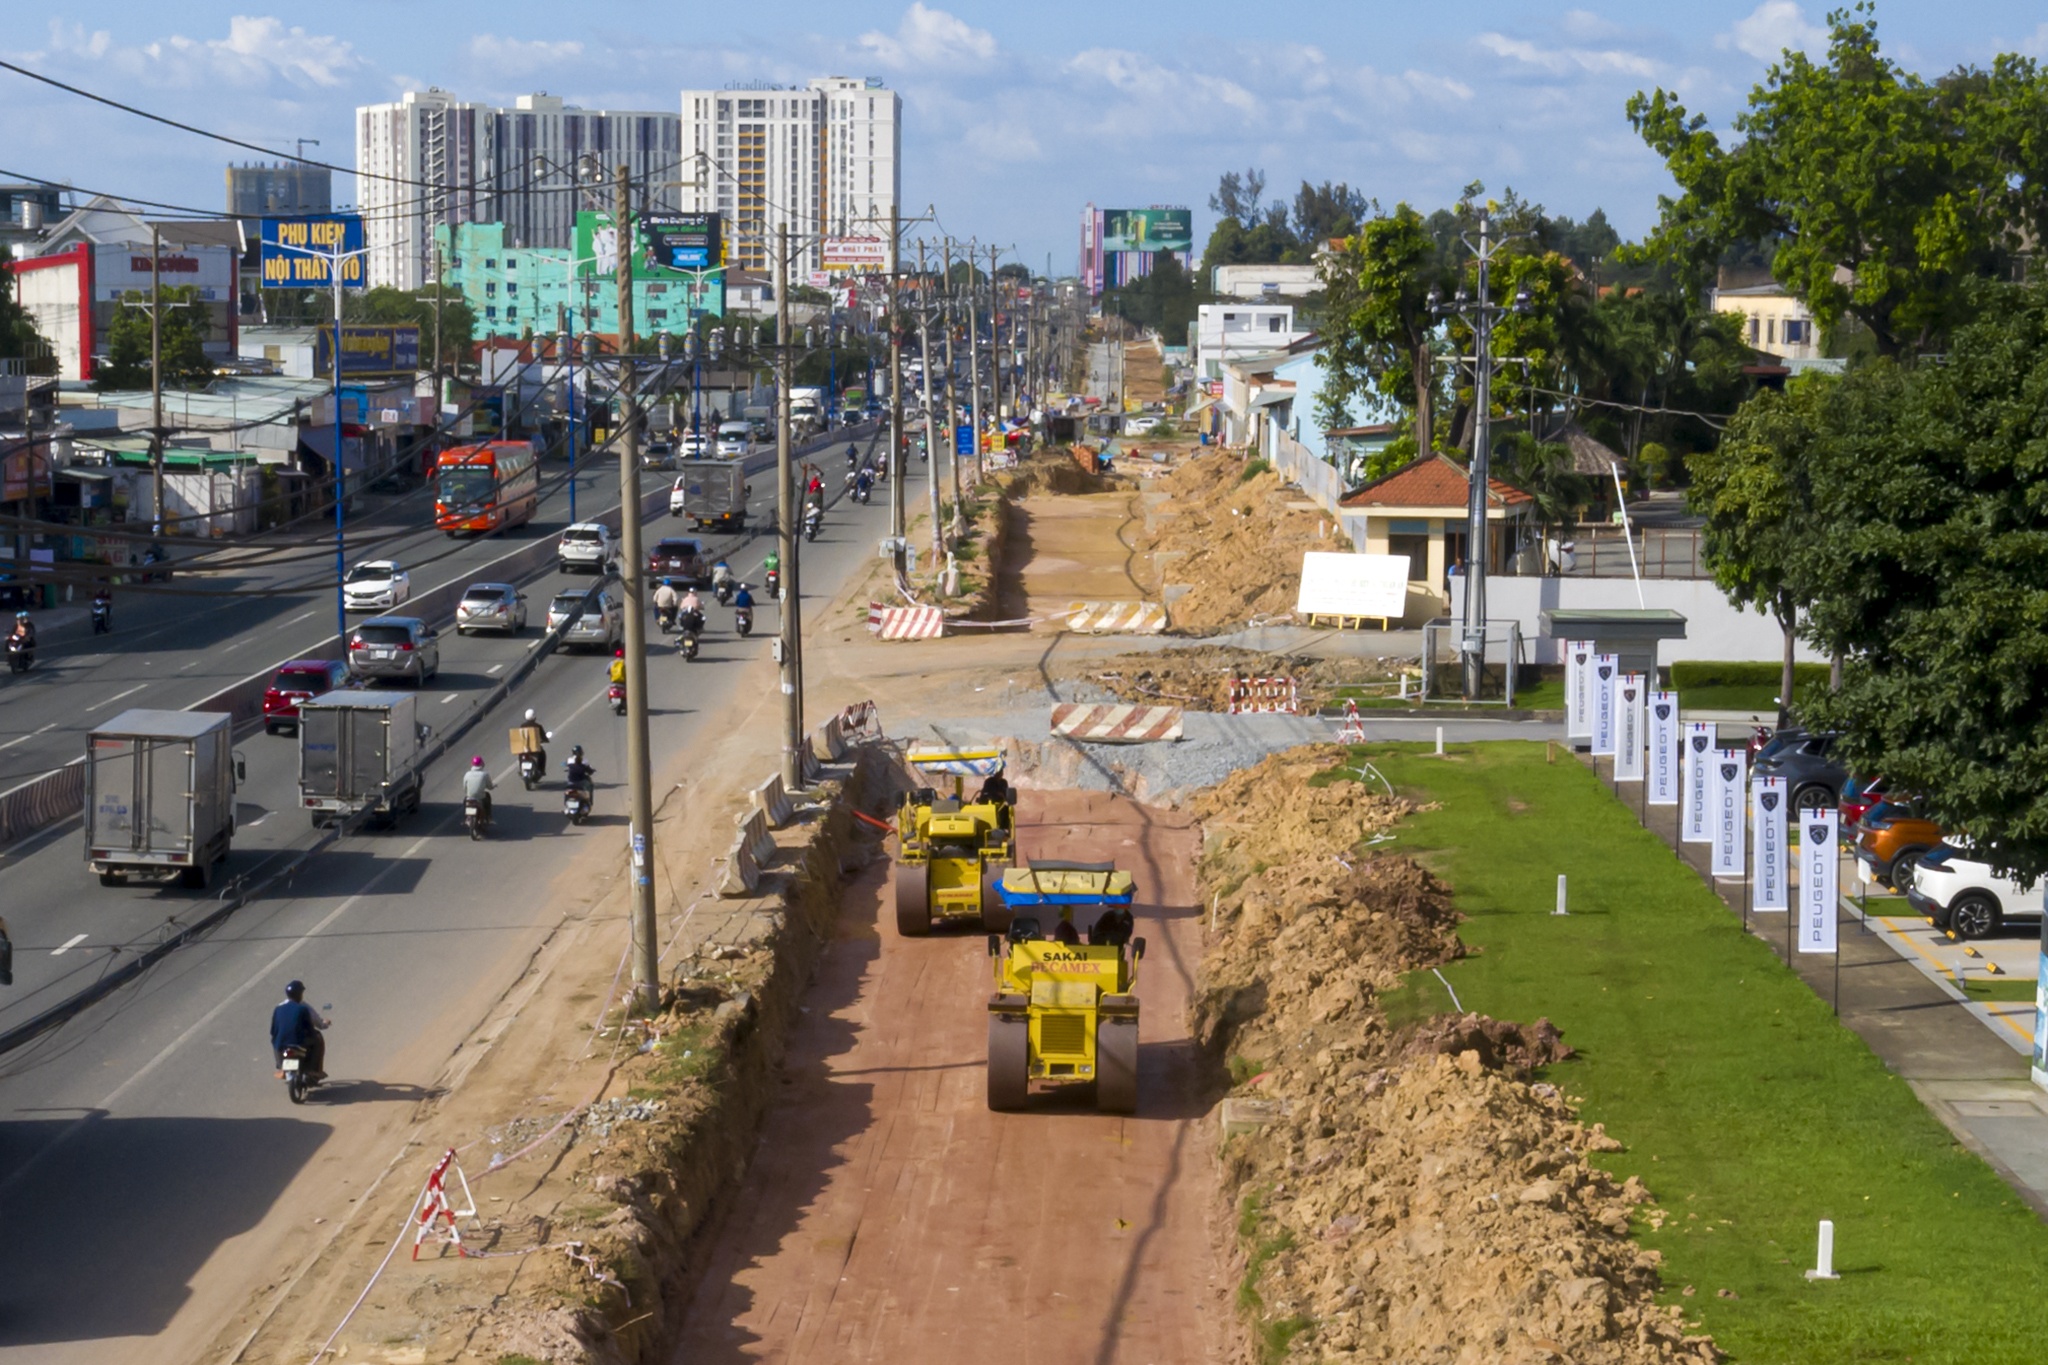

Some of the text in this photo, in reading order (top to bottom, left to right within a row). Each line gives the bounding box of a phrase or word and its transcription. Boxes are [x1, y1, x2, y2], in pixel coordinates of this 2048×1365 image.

[278, 220, 346, 250] PHỤ KIỆN
[265, 254, 360, 285] NỘI THẤT TÔ
[1600, 685, 1609, 749] PEUGEOT
[1625, 706, 1634, 767] PEUGEOT
[1659, 725, 1668, 797] PEUGEOT
[1693, 757, 1705, 835] PEUGEOT
[1723, 786, 1734, 867] PEUGEOT
[1765, 816, 1776, 902] PEUGEOT
[1812, 850, 1823, 942] PEUGEOT
[1030, 961, 1101, 974] BECAMEX
[1043, 952, 1088, 962] SAKAI
